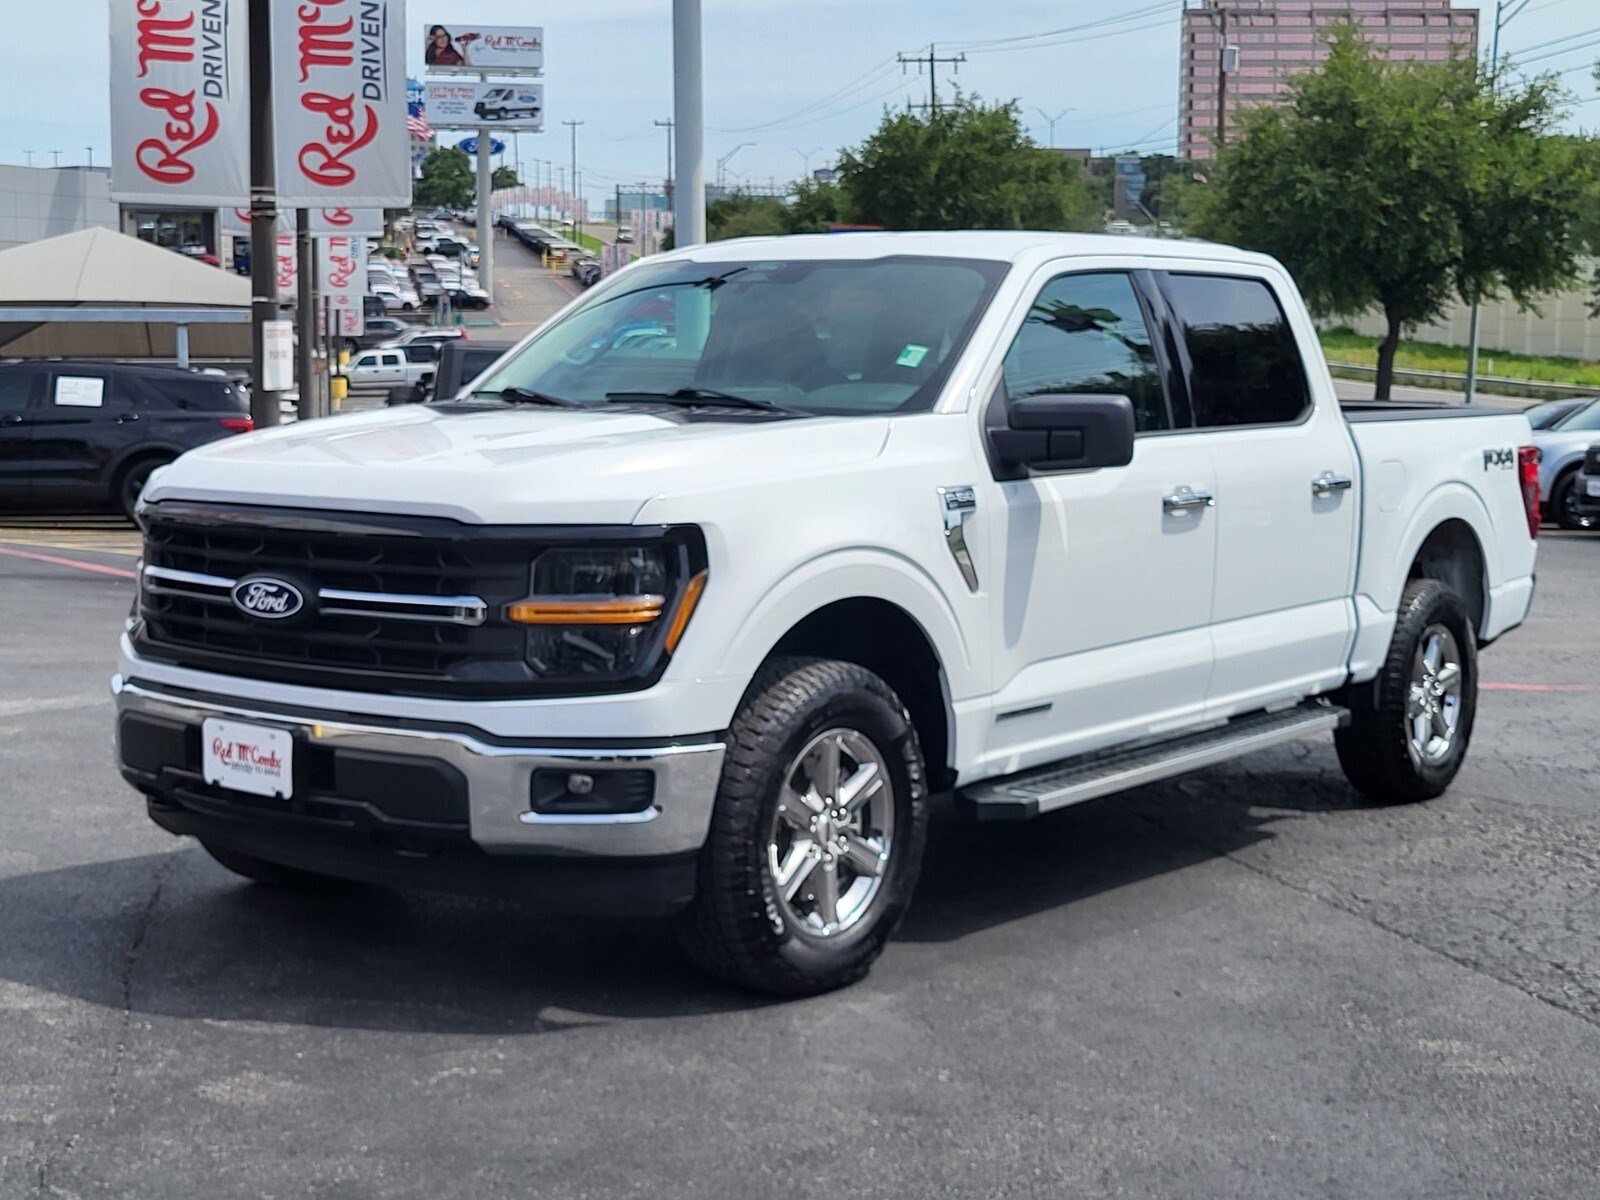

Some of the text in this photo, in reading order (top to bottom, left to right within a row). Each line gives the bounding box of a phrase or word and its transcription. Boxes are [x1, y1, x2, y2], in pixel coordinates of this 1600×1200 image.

[202, 0, 223, 100] DRIVEN
[298, 0, 354, 84] Mc
[360, 1, 382, 102] DRIVEN
[136, 0, 220, 185] Red Mc
[298, 92, 379, 187] Red
[329, 255, 356, 288] Red
[244, 583, 289, 612] Ford
